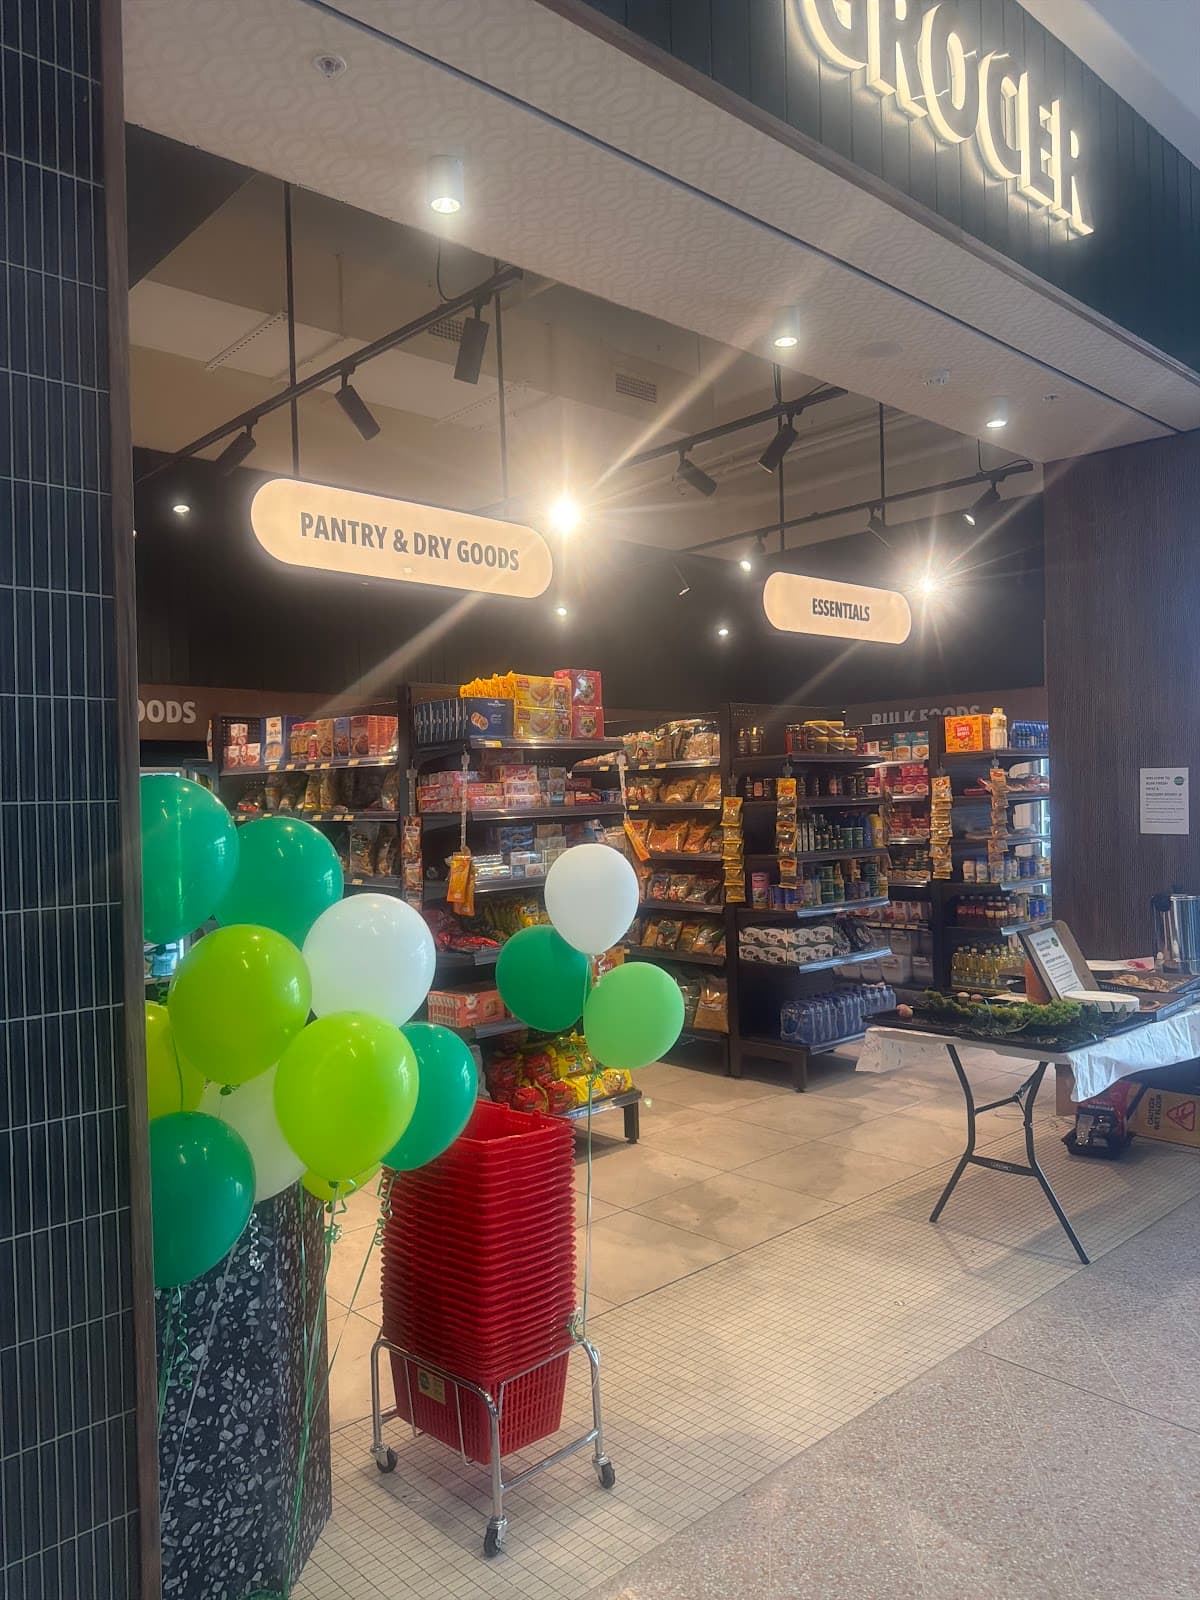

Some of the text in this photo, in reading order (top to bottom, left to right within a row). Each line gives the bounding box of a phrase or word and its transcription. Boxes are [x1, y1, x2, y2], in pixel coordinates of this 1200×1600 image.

[300, 511, 520, 571] PANTRY & DRY GOODS
[812, 597, 871, 622] ESSENTIALS
